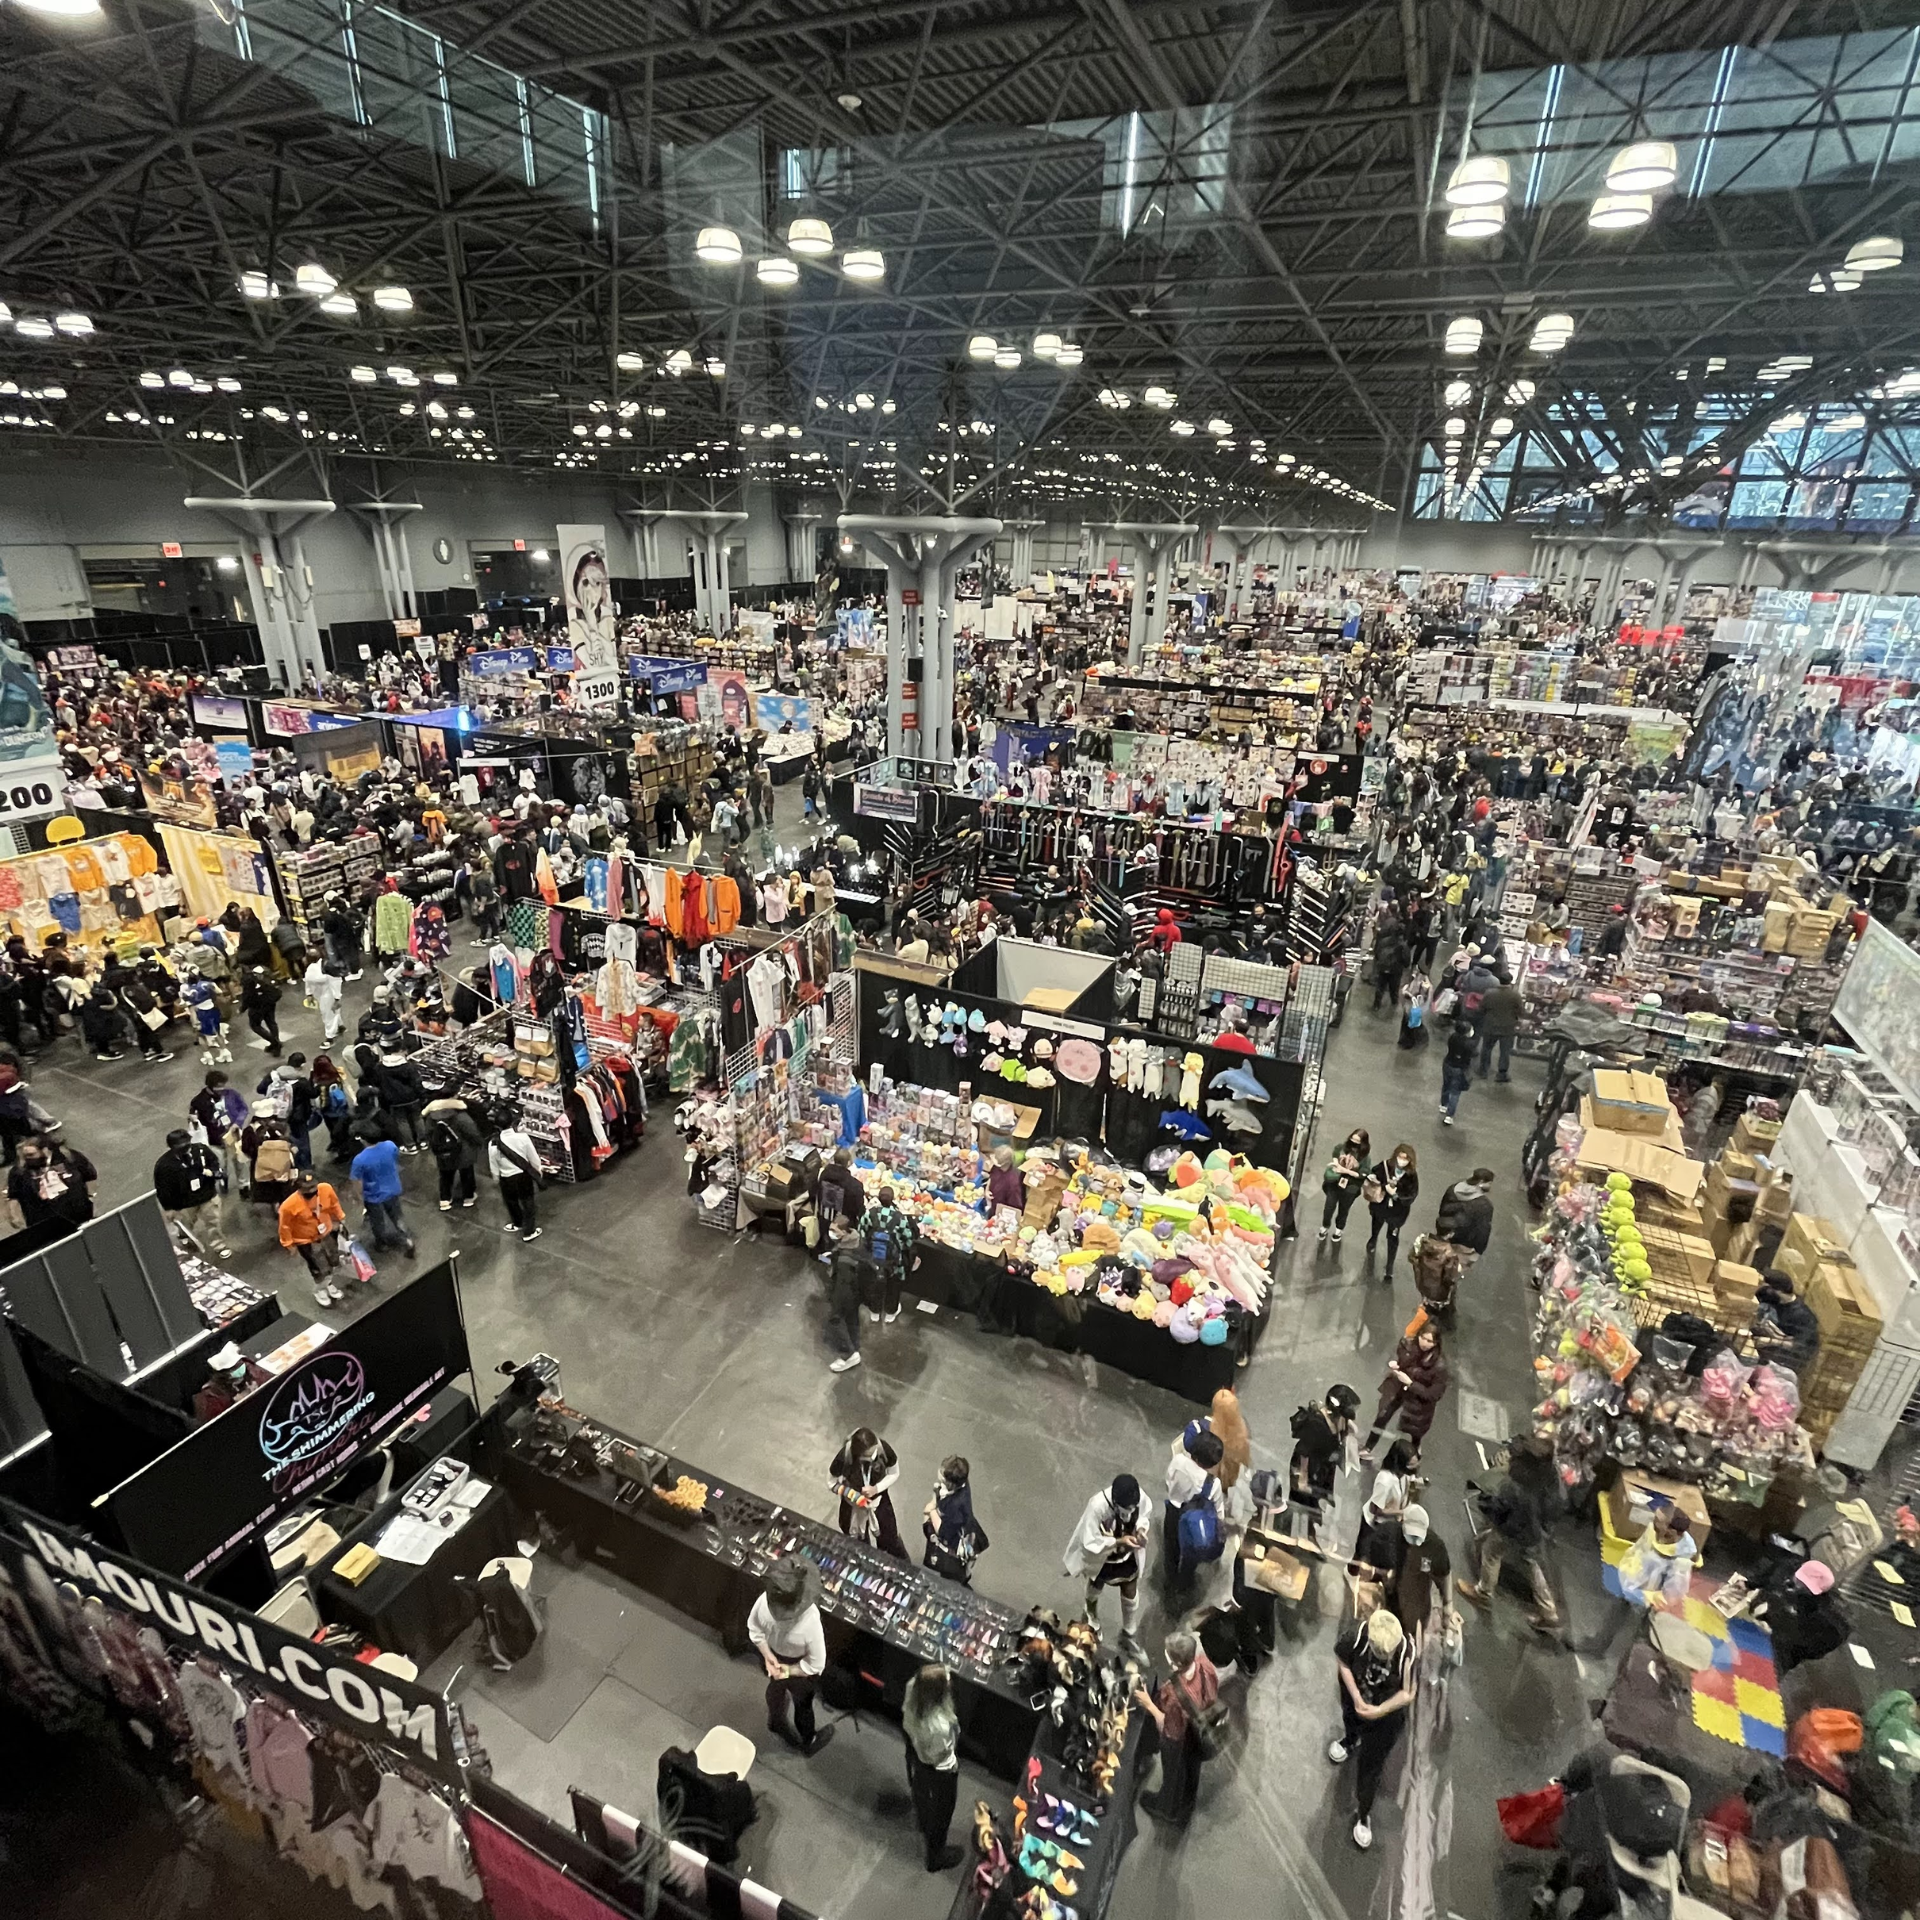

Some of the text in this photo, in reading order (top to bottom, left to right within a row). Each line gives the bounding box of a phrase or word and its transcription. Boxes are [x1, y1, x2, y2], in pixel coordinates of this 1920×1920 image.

[585, 681, 615, 700] 1300
[262, 1391, 376, 1482] THE SHIMMERING
[315, 1461, 336, 1482] CAST
